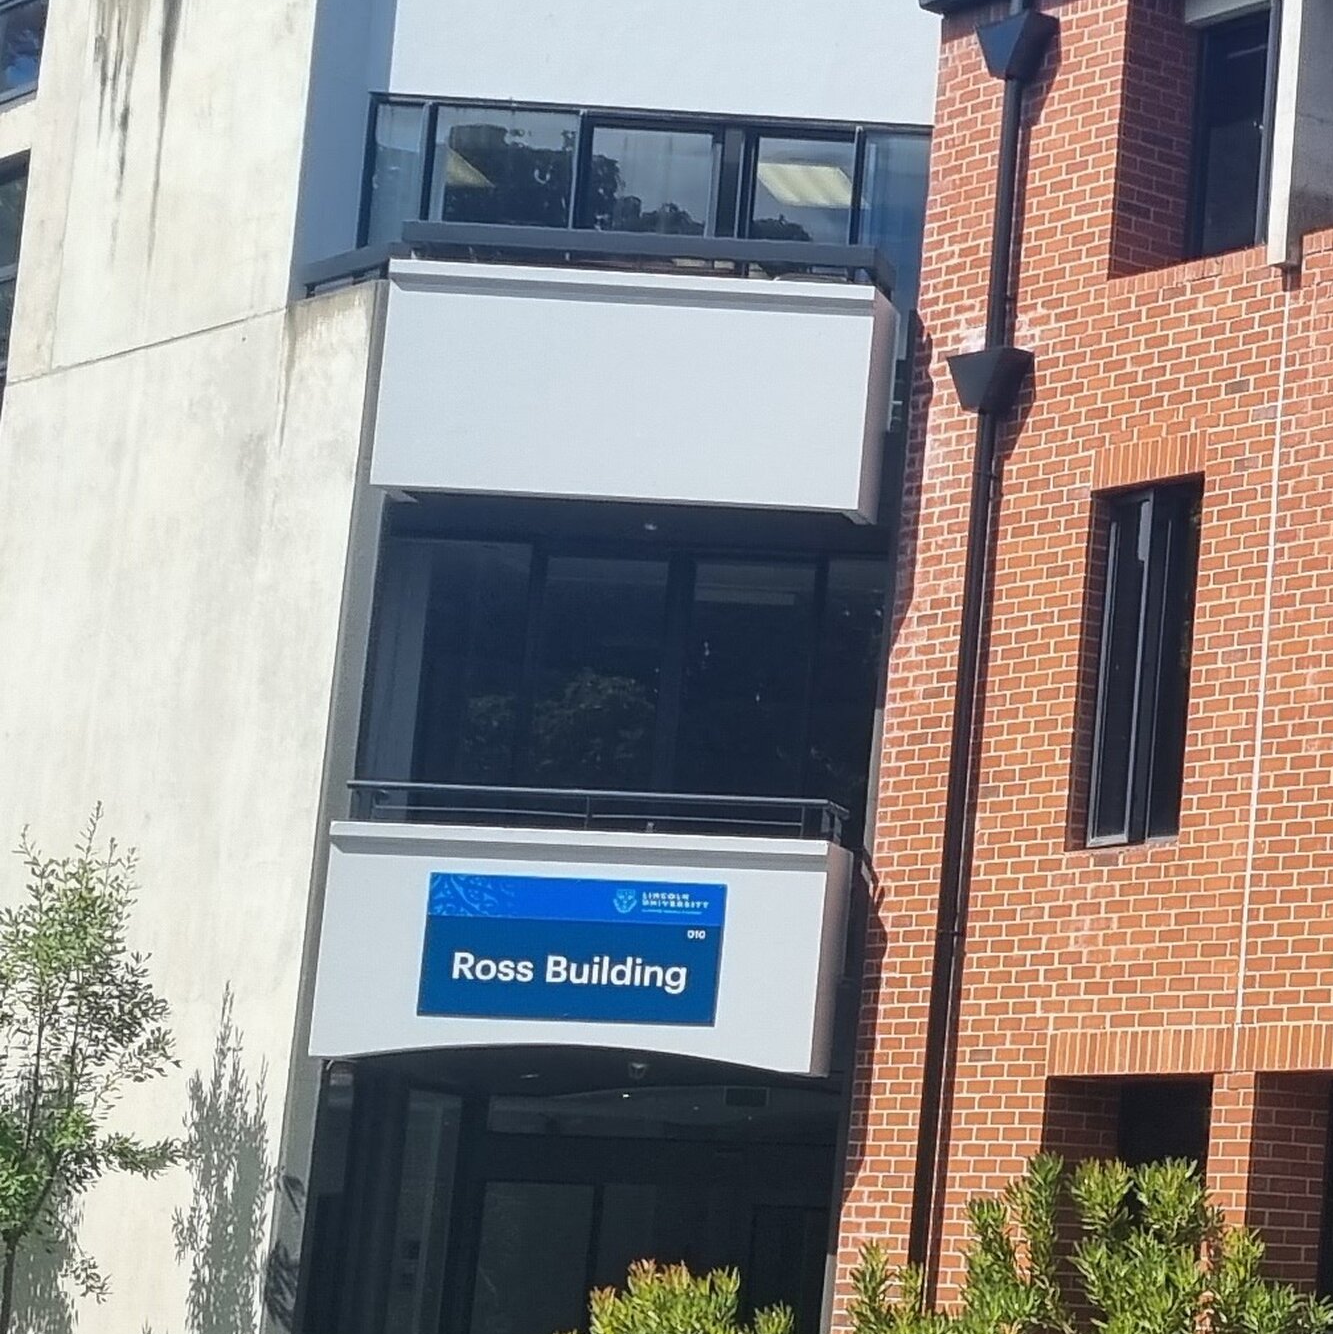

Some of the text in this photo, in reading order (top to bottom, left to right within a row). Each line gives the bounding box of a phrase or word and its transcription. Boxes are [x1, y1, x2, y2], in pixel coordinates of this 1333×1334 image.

[686, 929, 706, 940] 010
[452, 951, 688, 995] Ross Building
